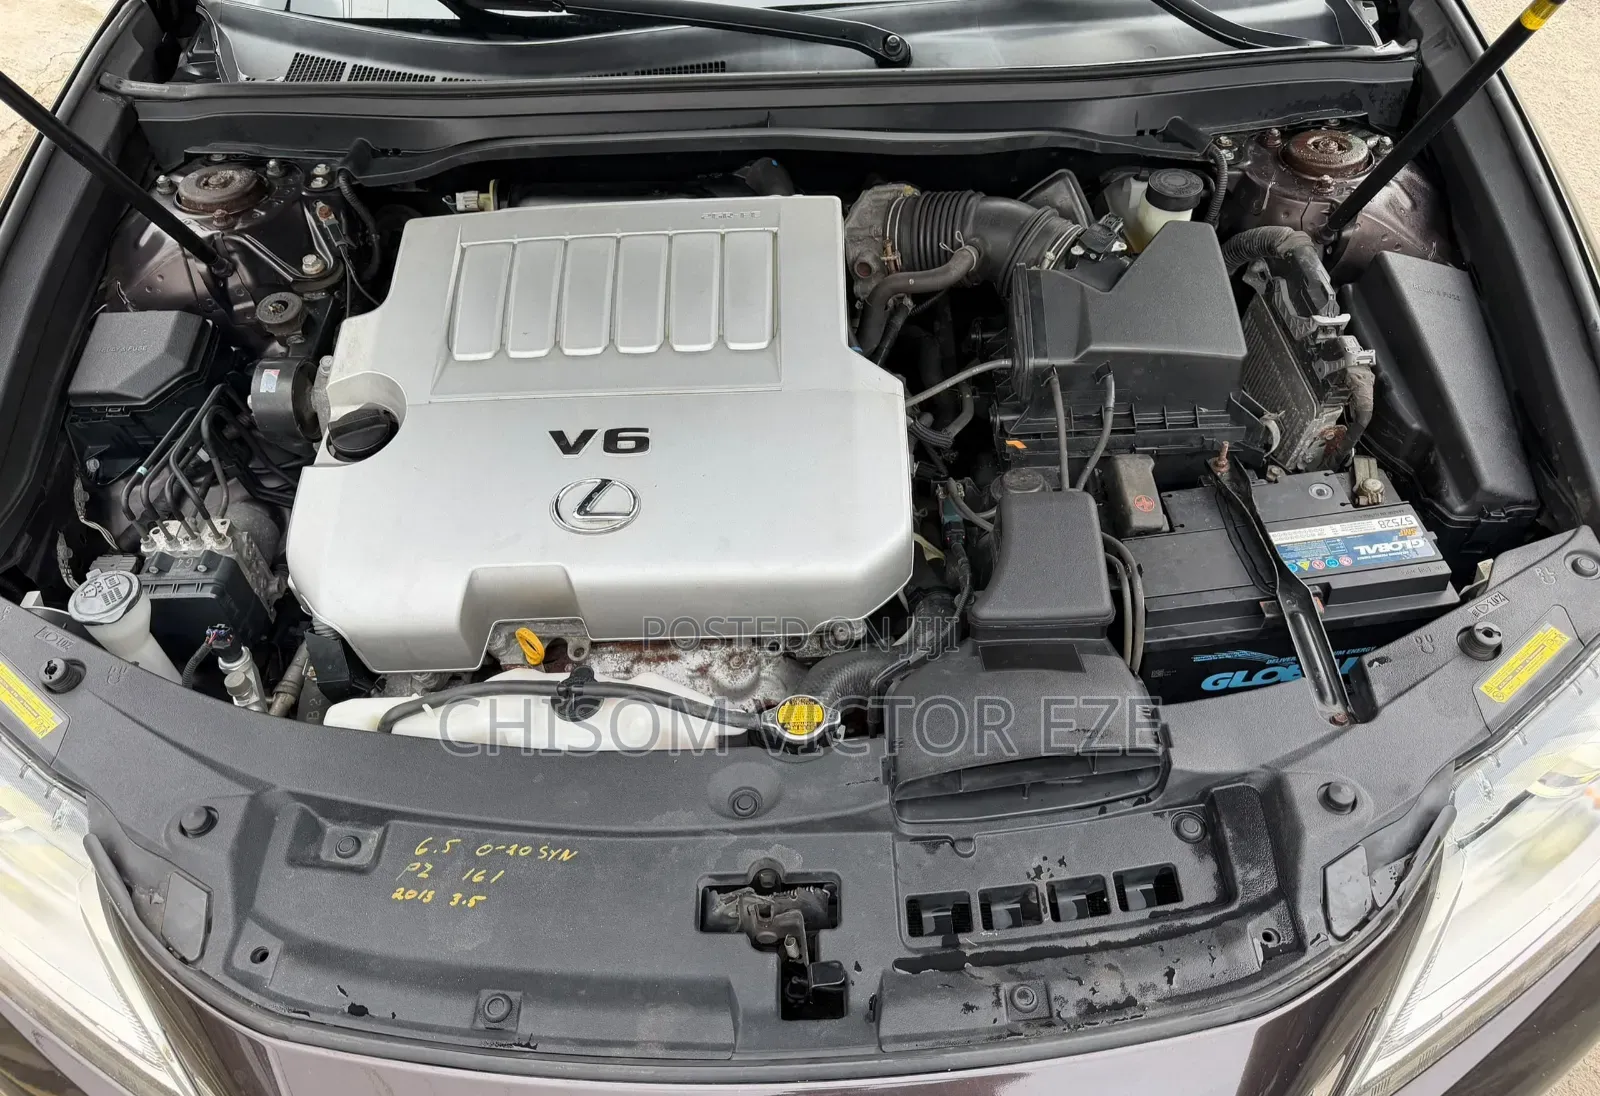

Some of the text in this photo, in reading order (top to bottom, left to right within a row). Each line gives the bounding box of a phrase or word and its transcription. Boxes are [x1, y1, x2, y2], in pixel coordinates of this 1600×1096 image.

[546, 427, 651, 458] V6
[1377, 516, 1414, 529] 57528
[1353, 538, 1426, 556] GLOBAL
[1346, 646, 1377, 655] ENERGY
[415, 837, 461, 856] 6.5
[537, 843, 578, 862] SYN
[462, 868, 505, 884] 161
[449, 893, 487, 908] 3.5
